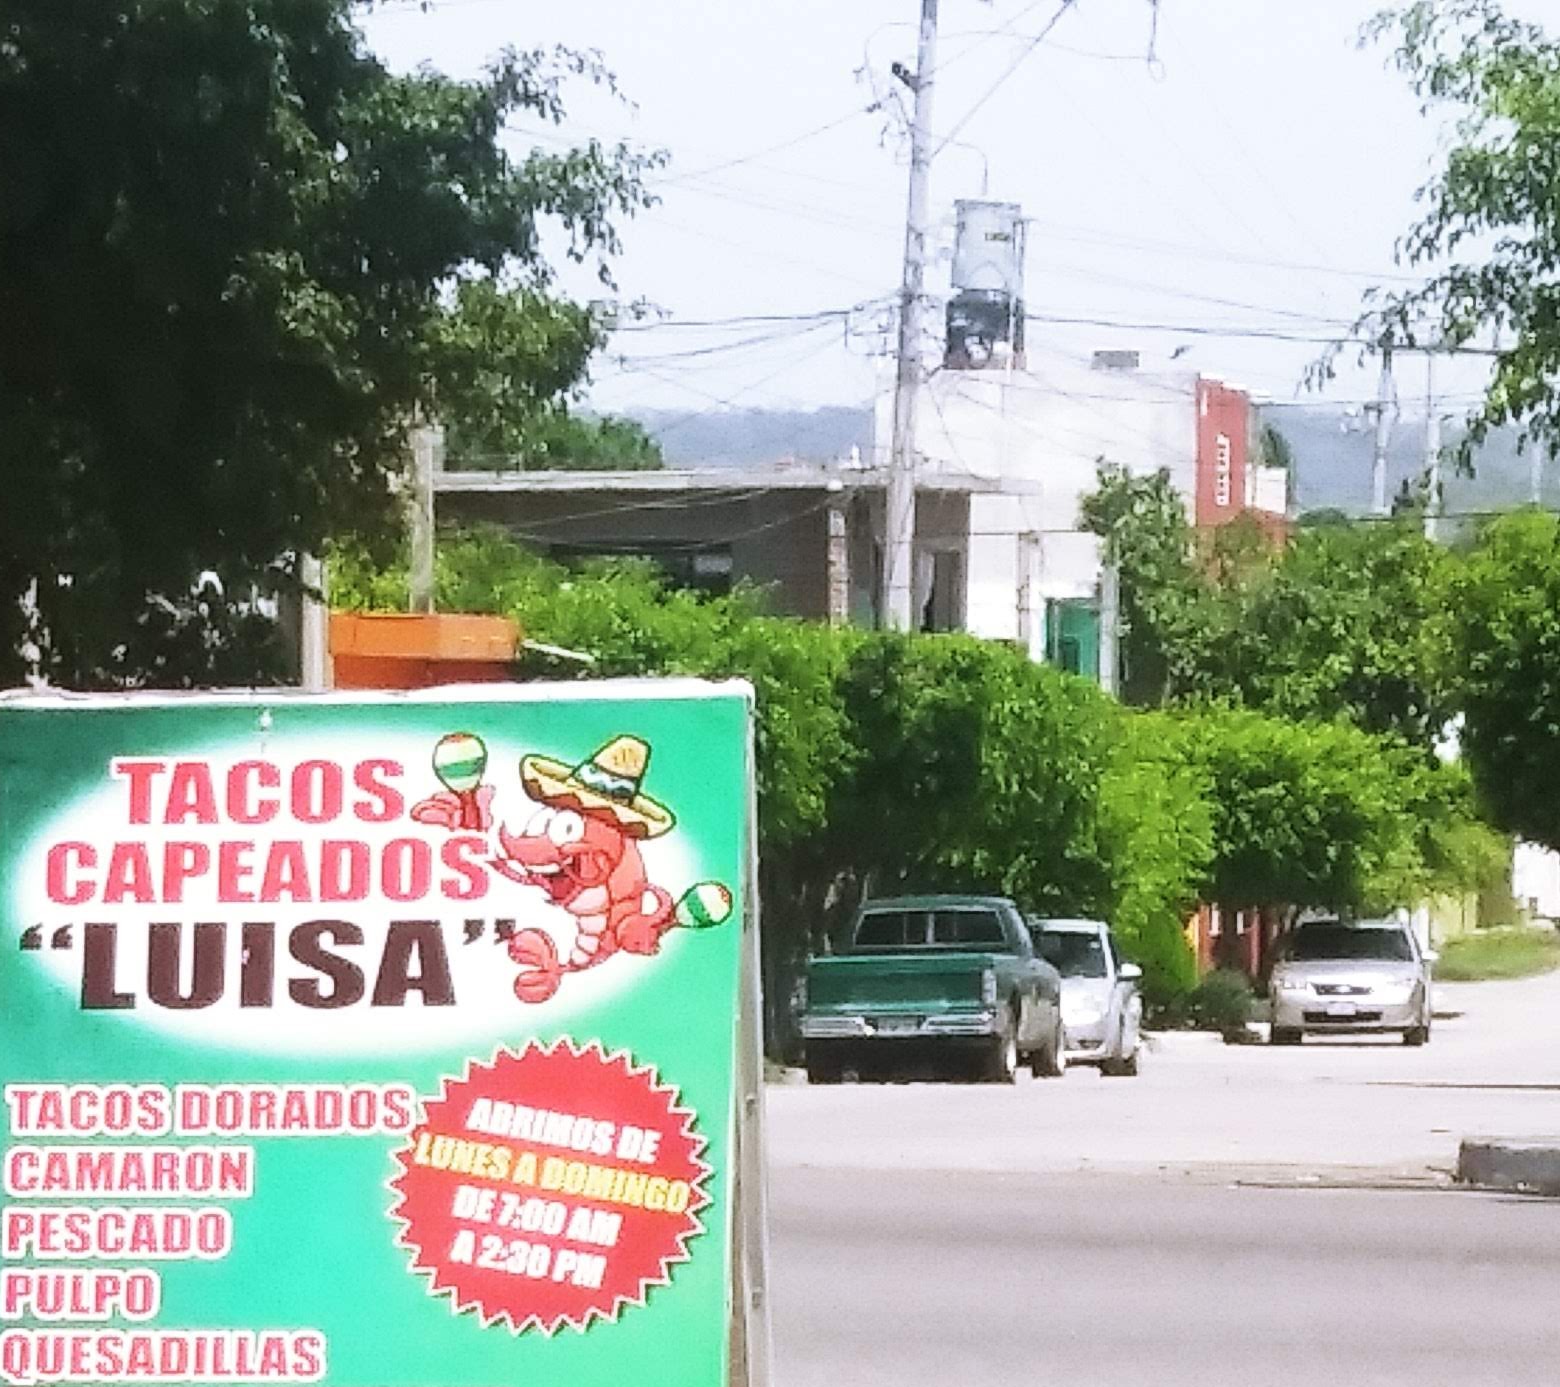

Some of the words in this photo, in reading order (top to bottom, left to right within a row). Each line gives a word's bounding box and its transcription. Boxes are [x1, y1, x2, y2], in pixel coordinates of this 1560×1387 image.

[116, 759, 405, 824] TACOS
[47, 837, 491, 904] CAPEADOS
[10, 1088, 166, 1130] TACOS
[181, 1088, 411, 1130] DORADOS
[465, 1097, 616, 1155] ABRIMOS
[615, 1125, 661, 1164] DE
[9, 1150, 249, 1192] CAMARON
[414, 1132, 512, 1181] LUNES
[512, 1152, 538, 1186] A
[540, 1156, 692, 1214] DOMINGO
[7, 1212, 226, 1253] PESCADO
[452, 1184, 497, 1222] DE
[496, 1192, 568, 1236] 7:00
[566, 1206, 624, 1247] AM
[448, 1229, 475, 1264] A
[476, 1234, 552, 1279] 2:30
[552, 1249, 608, 1289] PM
[5, 1273, 155, 1315] PULPO
[1, 1334, 322, 1379] QUESADILLAS
